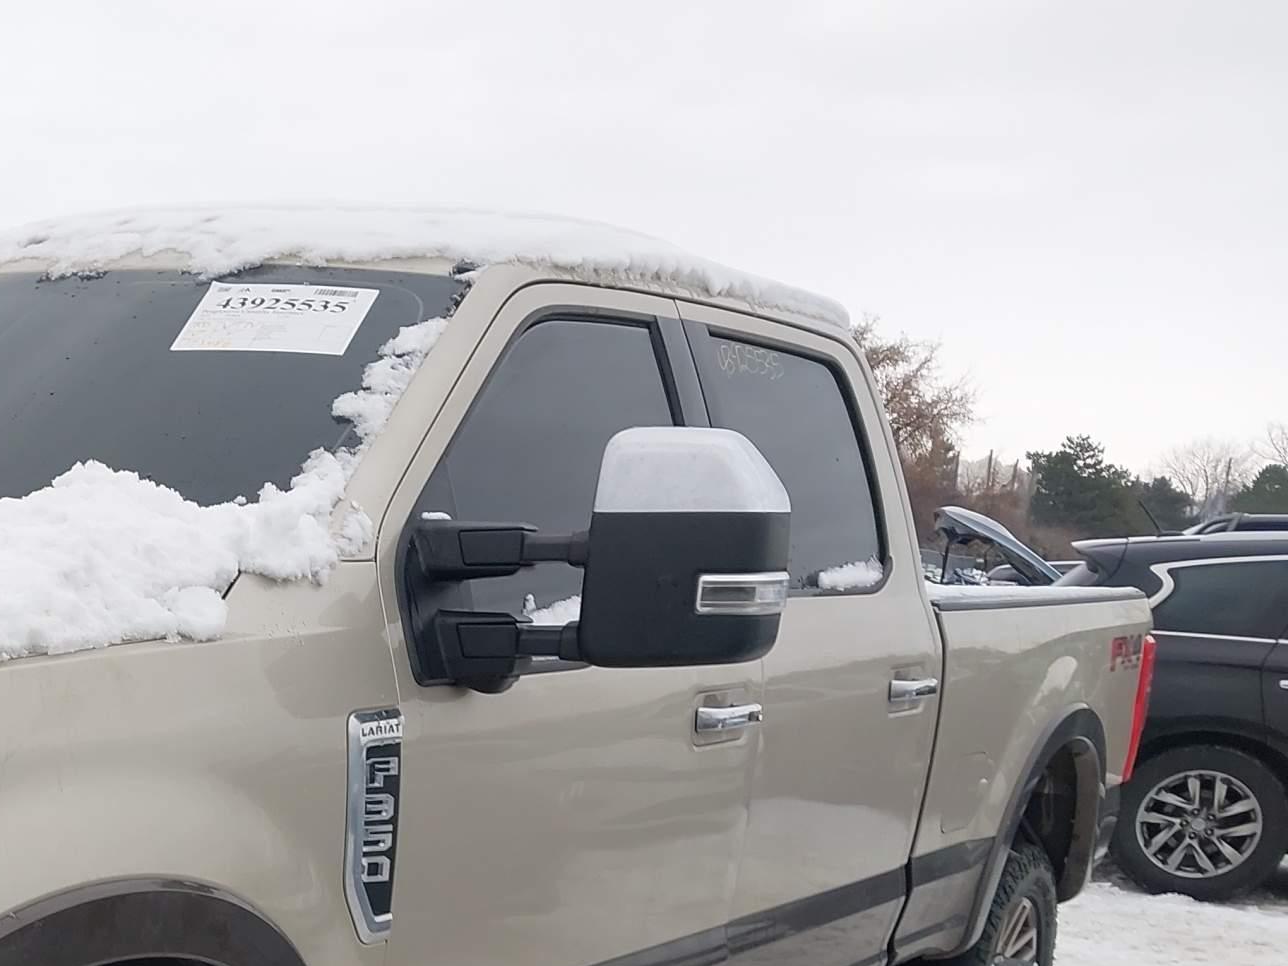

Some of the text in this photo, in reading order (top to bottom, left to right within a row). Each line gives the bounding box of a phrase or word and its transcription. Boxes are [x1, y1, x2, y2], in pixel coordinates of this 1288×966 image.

[216, 296, 350, 314] 43925535
[361, 722, 401, 738] LARIAT
[360, 756, 399, 883] F350
